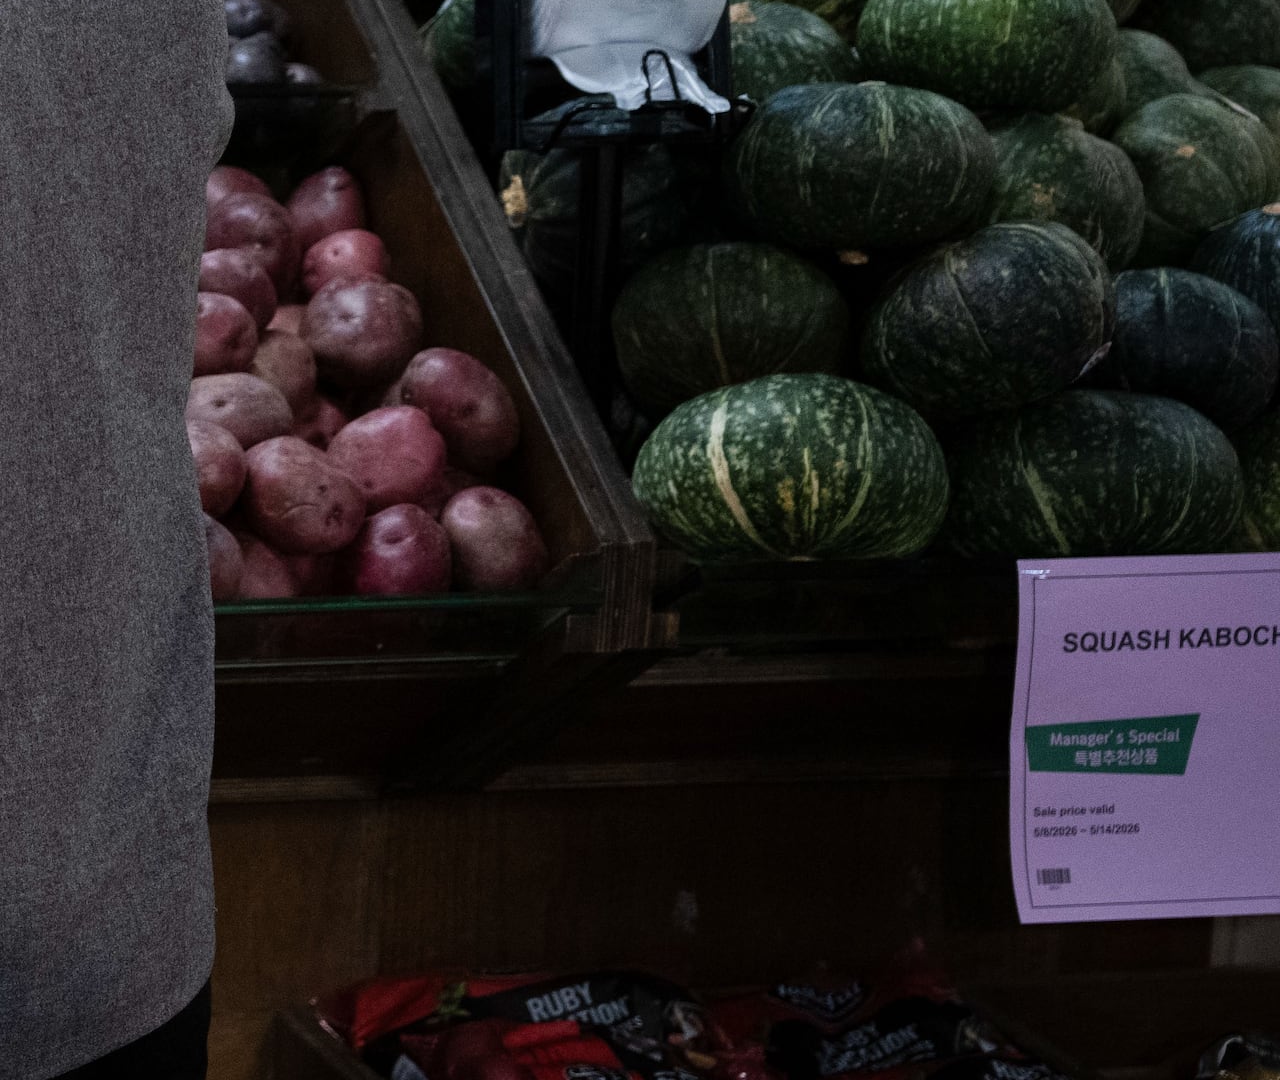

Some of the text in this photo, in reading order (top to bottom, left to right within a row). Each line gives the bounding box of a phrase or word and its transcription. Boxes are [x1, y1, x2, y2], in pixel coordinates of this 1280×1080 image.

[1063, 629, 1170, 654] SQUASH
[1128, 727, 1180, 745] Special
[1074, 748, 1158, 766] 특별추천상품
[1034, 803, 1115, 818] Sale price valid
[1090, 823, 1141, 836] 5/14/2026
[526, 981, 593, 1022] RUBY
